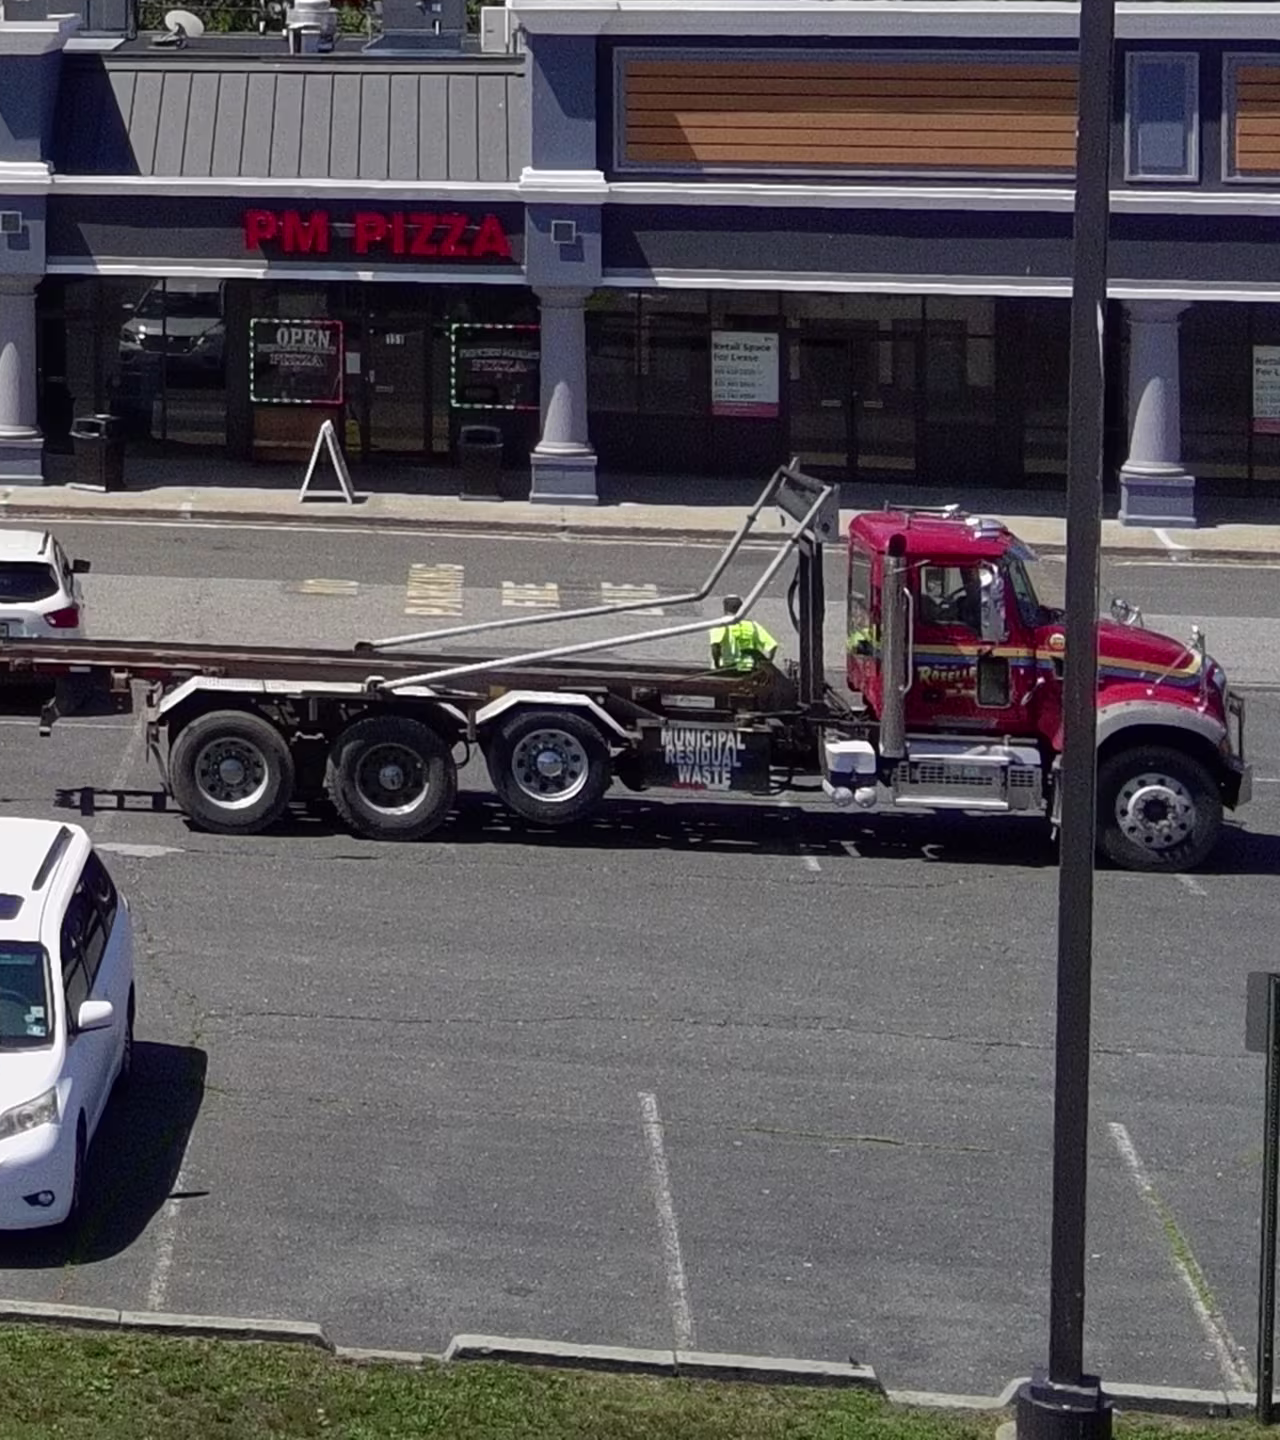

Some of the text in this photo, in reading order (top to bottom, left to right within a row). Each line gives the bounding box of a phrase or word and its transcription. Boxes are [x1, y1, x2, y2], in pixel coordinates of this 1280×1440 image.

[244, 208, 512, 256] PM PIZZA
[276, 328, 330, 347] OPEN
[660, 728, 746, 750] MUNICIPAL
[664, 744, 741, 767] RESIDUAL
[678, 766, 732, 785] WASTE
